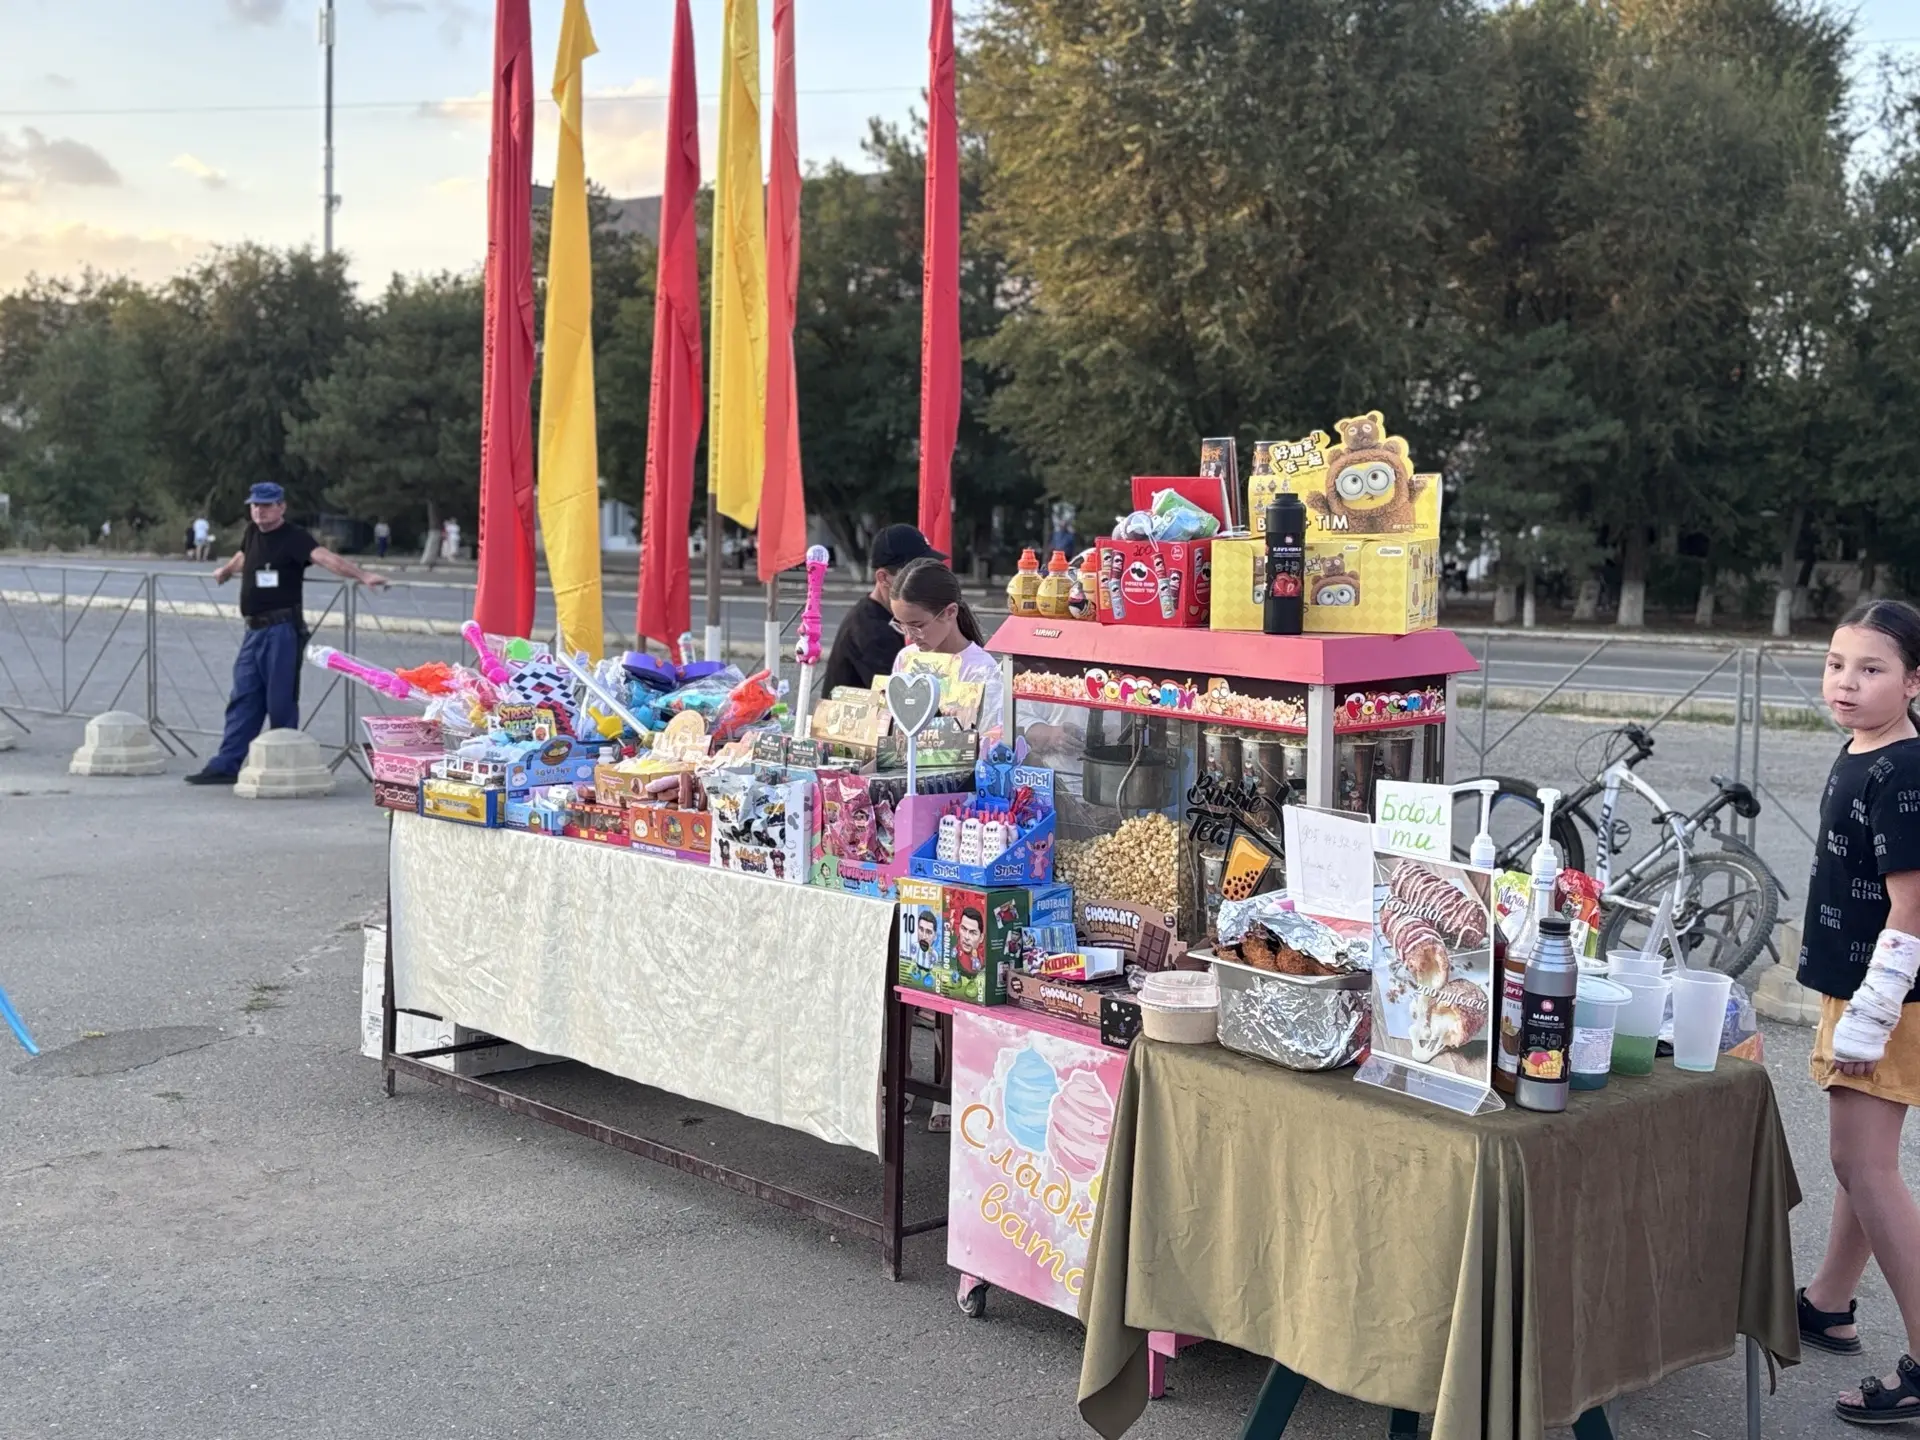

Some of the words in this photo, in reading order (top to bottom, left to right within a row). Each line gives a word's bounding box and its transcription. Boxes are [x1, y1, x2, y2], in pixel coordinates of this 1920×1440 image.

[1315, 514, 1349, 531] TIM
[1033, 627, 1062, 639] AIRHOT
[1084, 667, 1199, 710] POPCORN
[1344, 690, 1436, 720] POPCORN
[1014, 768, 1050, 788] STITCH
[1187, 769, 1265, 814] Bubble
[1186, 807, 1228, 846] Tea
[1391, 829, 1436, 851] ти
[933, 862, 960, 880] STITCH
[994, 863, 1024, 877] STITCH
[902, 884, 941, 901] MESSI
[1036, 897, 1070, 911] FOOTBALL
[903, 913, 915, 934] 10
[1051, 910, 1070, 922] STAR
[1084, 905, 1141, 930] CHOCOLATE
[1039, 985, 1083, 1008] CHOCOLATE
[1415, 983, 1438, 998] 200
[1436, 990, 1488, 1011] рублей
[1532, 1013, 1560, 1022] МАНГО
